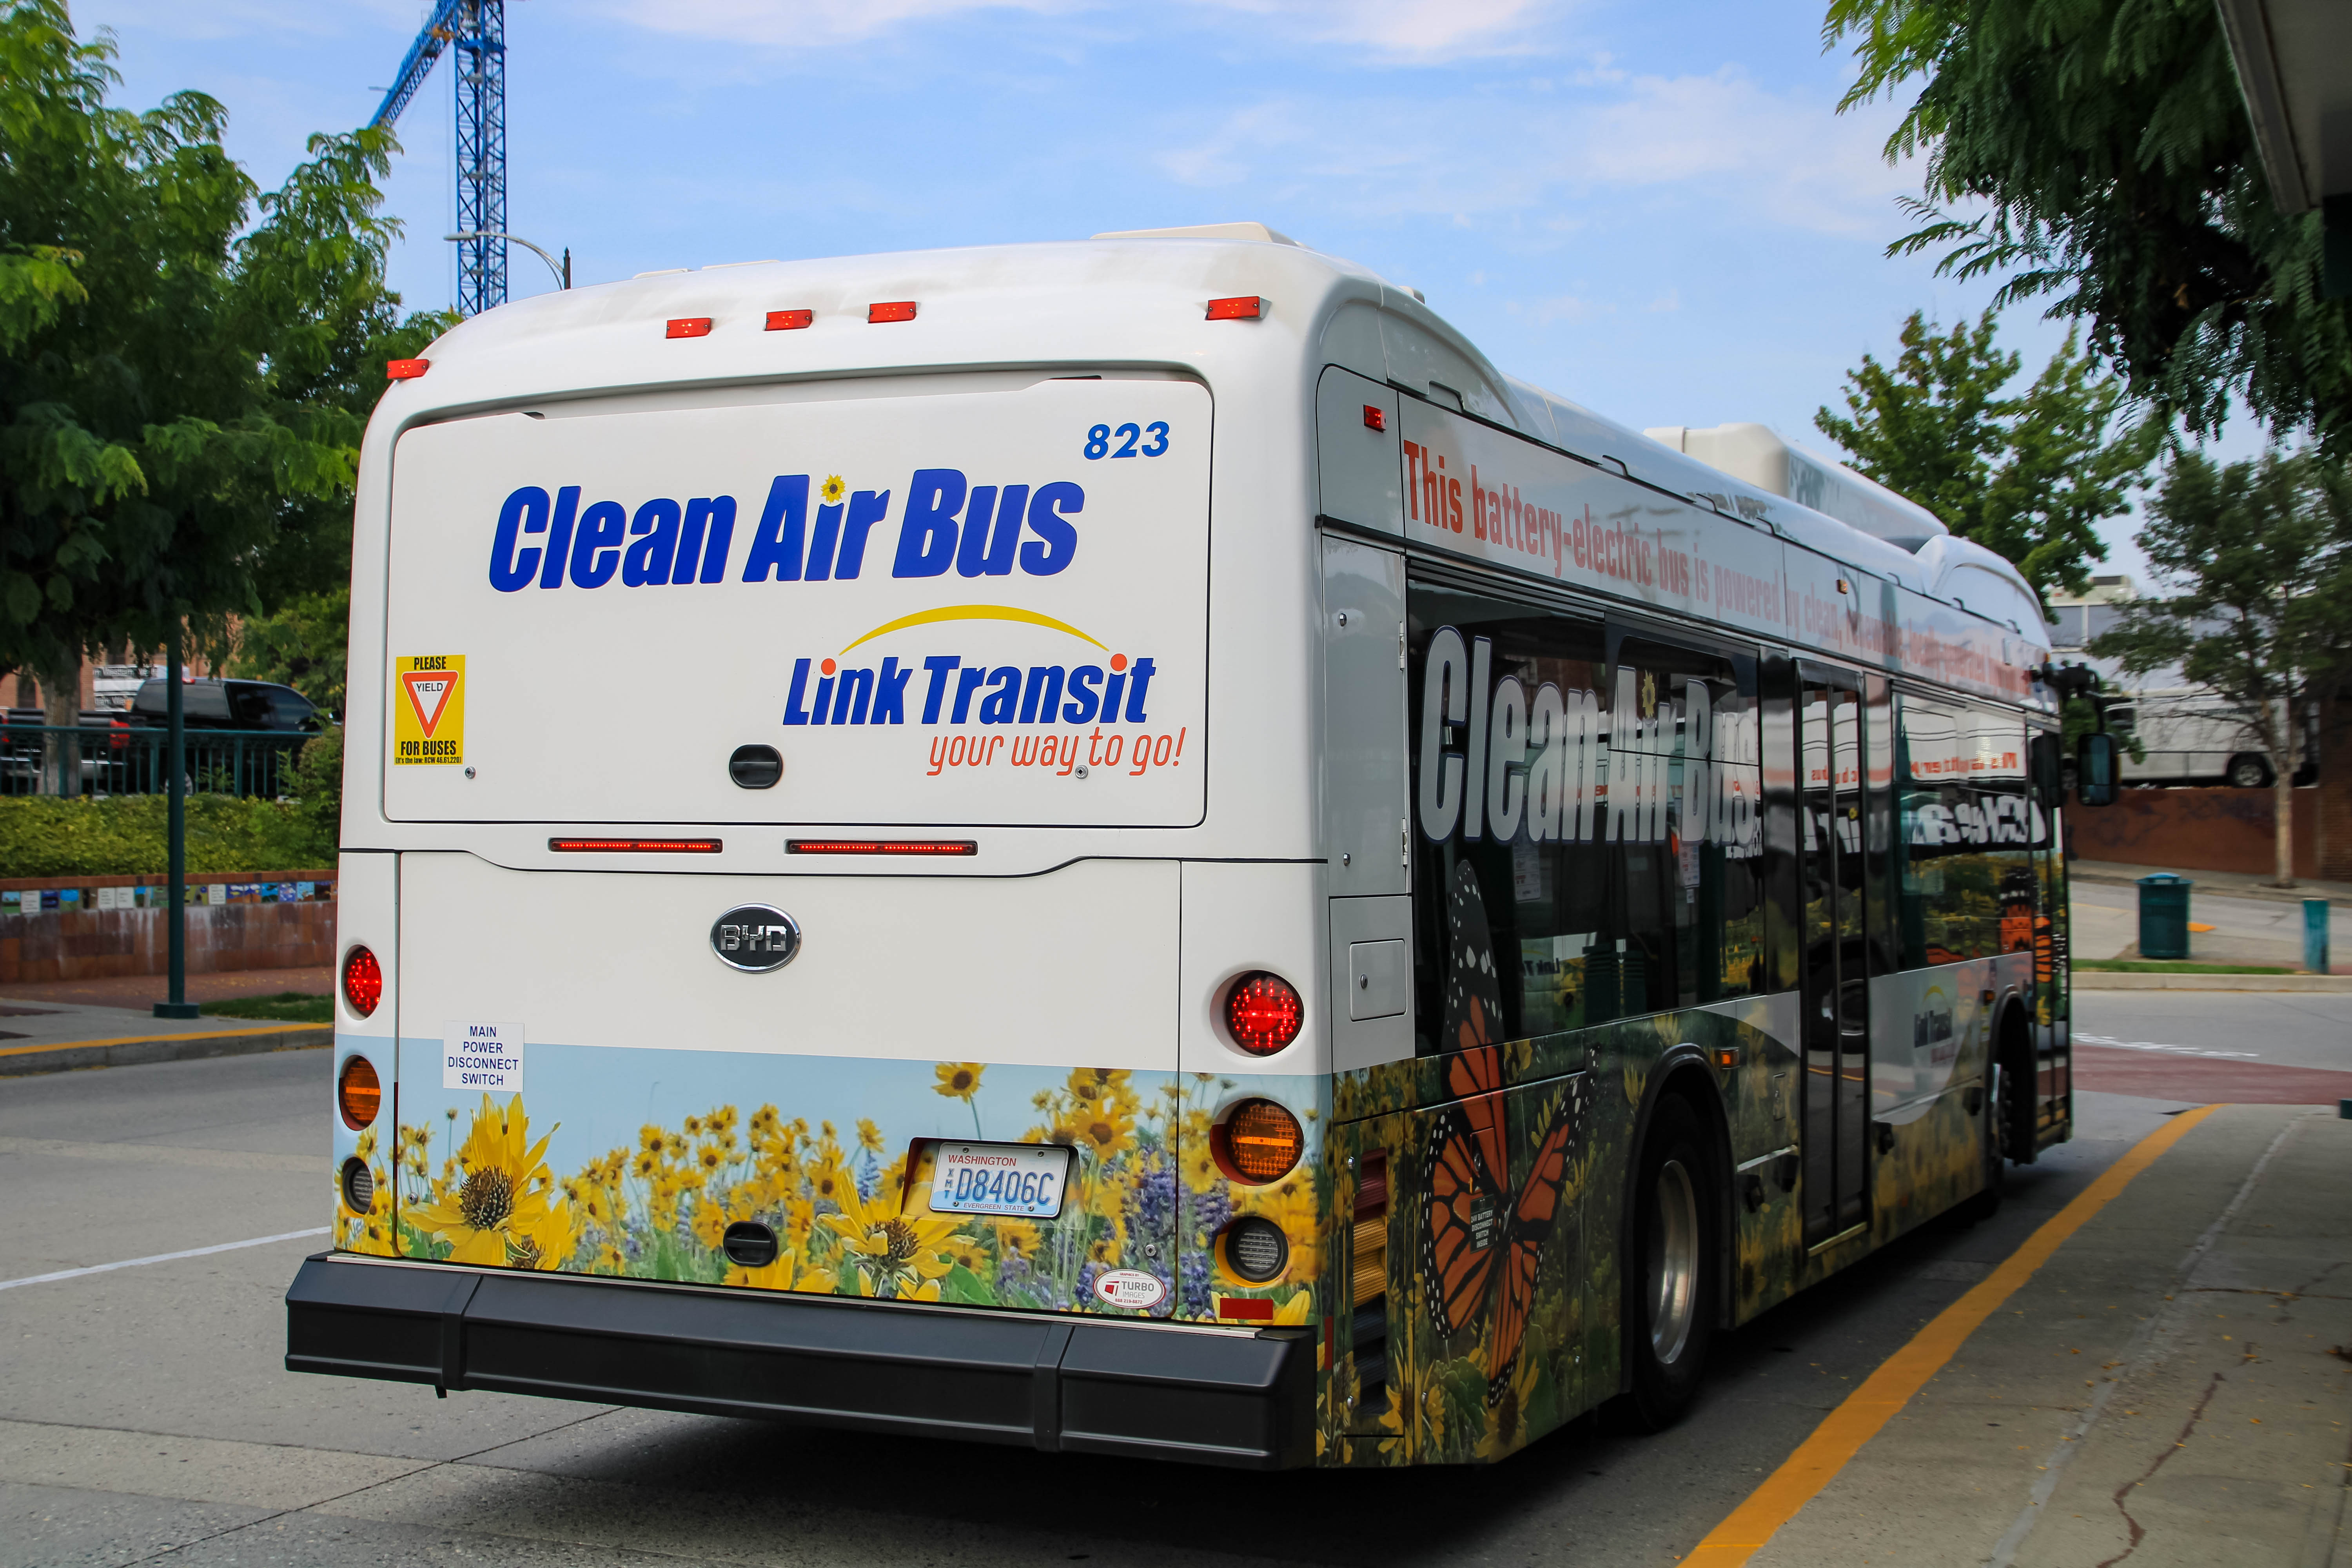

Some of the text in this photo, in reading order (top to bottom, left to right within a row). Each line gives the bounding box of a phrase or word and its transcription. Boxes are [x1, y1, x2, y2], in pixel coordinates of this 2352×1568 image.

[1084, 421, 1169, 460] 823
[489, 469, 1084, 592] Clean Air Bus
[1404, 440, 1463, 534] This
[1471, 464, 1651, 586] battery-electric
[1657, 528, 1689, 597] bus
[1693, 543, 1709, 602] is
[1714, 564, 1780, 623] powered
[414, 656, 446, 670] PLEASE
[416, 682, 443, 692] YIELD
[784, 653, 1156, 725] Link Transit
[1419, 625, 1756, 848] Clean Air Bus
[401, 740, 457, 756] FOR BUSES
[927, 726, 1186, 776] your way to go!
[720, 924, 788, 952] BYD
[470, 1025, 497, 1038] MAIN
[463, 1041, 503, 1054] POWER
[448, 1056, 519, 1071] DISCONNECT
[462, 1073, 504, 1085] SWITCH
[948, 1154, 1017, 1167] WASHINGTON
[956, 1168, 1054, 1205] D8406C
[1478, 1210, 1493, 1221] BATTERY
[1472, 1218, 1493, 1232] DISCONNECT
[1476, 1229, 1489, 1240] SWITCH
[1477, 1238, 1488, 1248] INSIDE
[1122, 1281, 1154, 1292] TURBO
